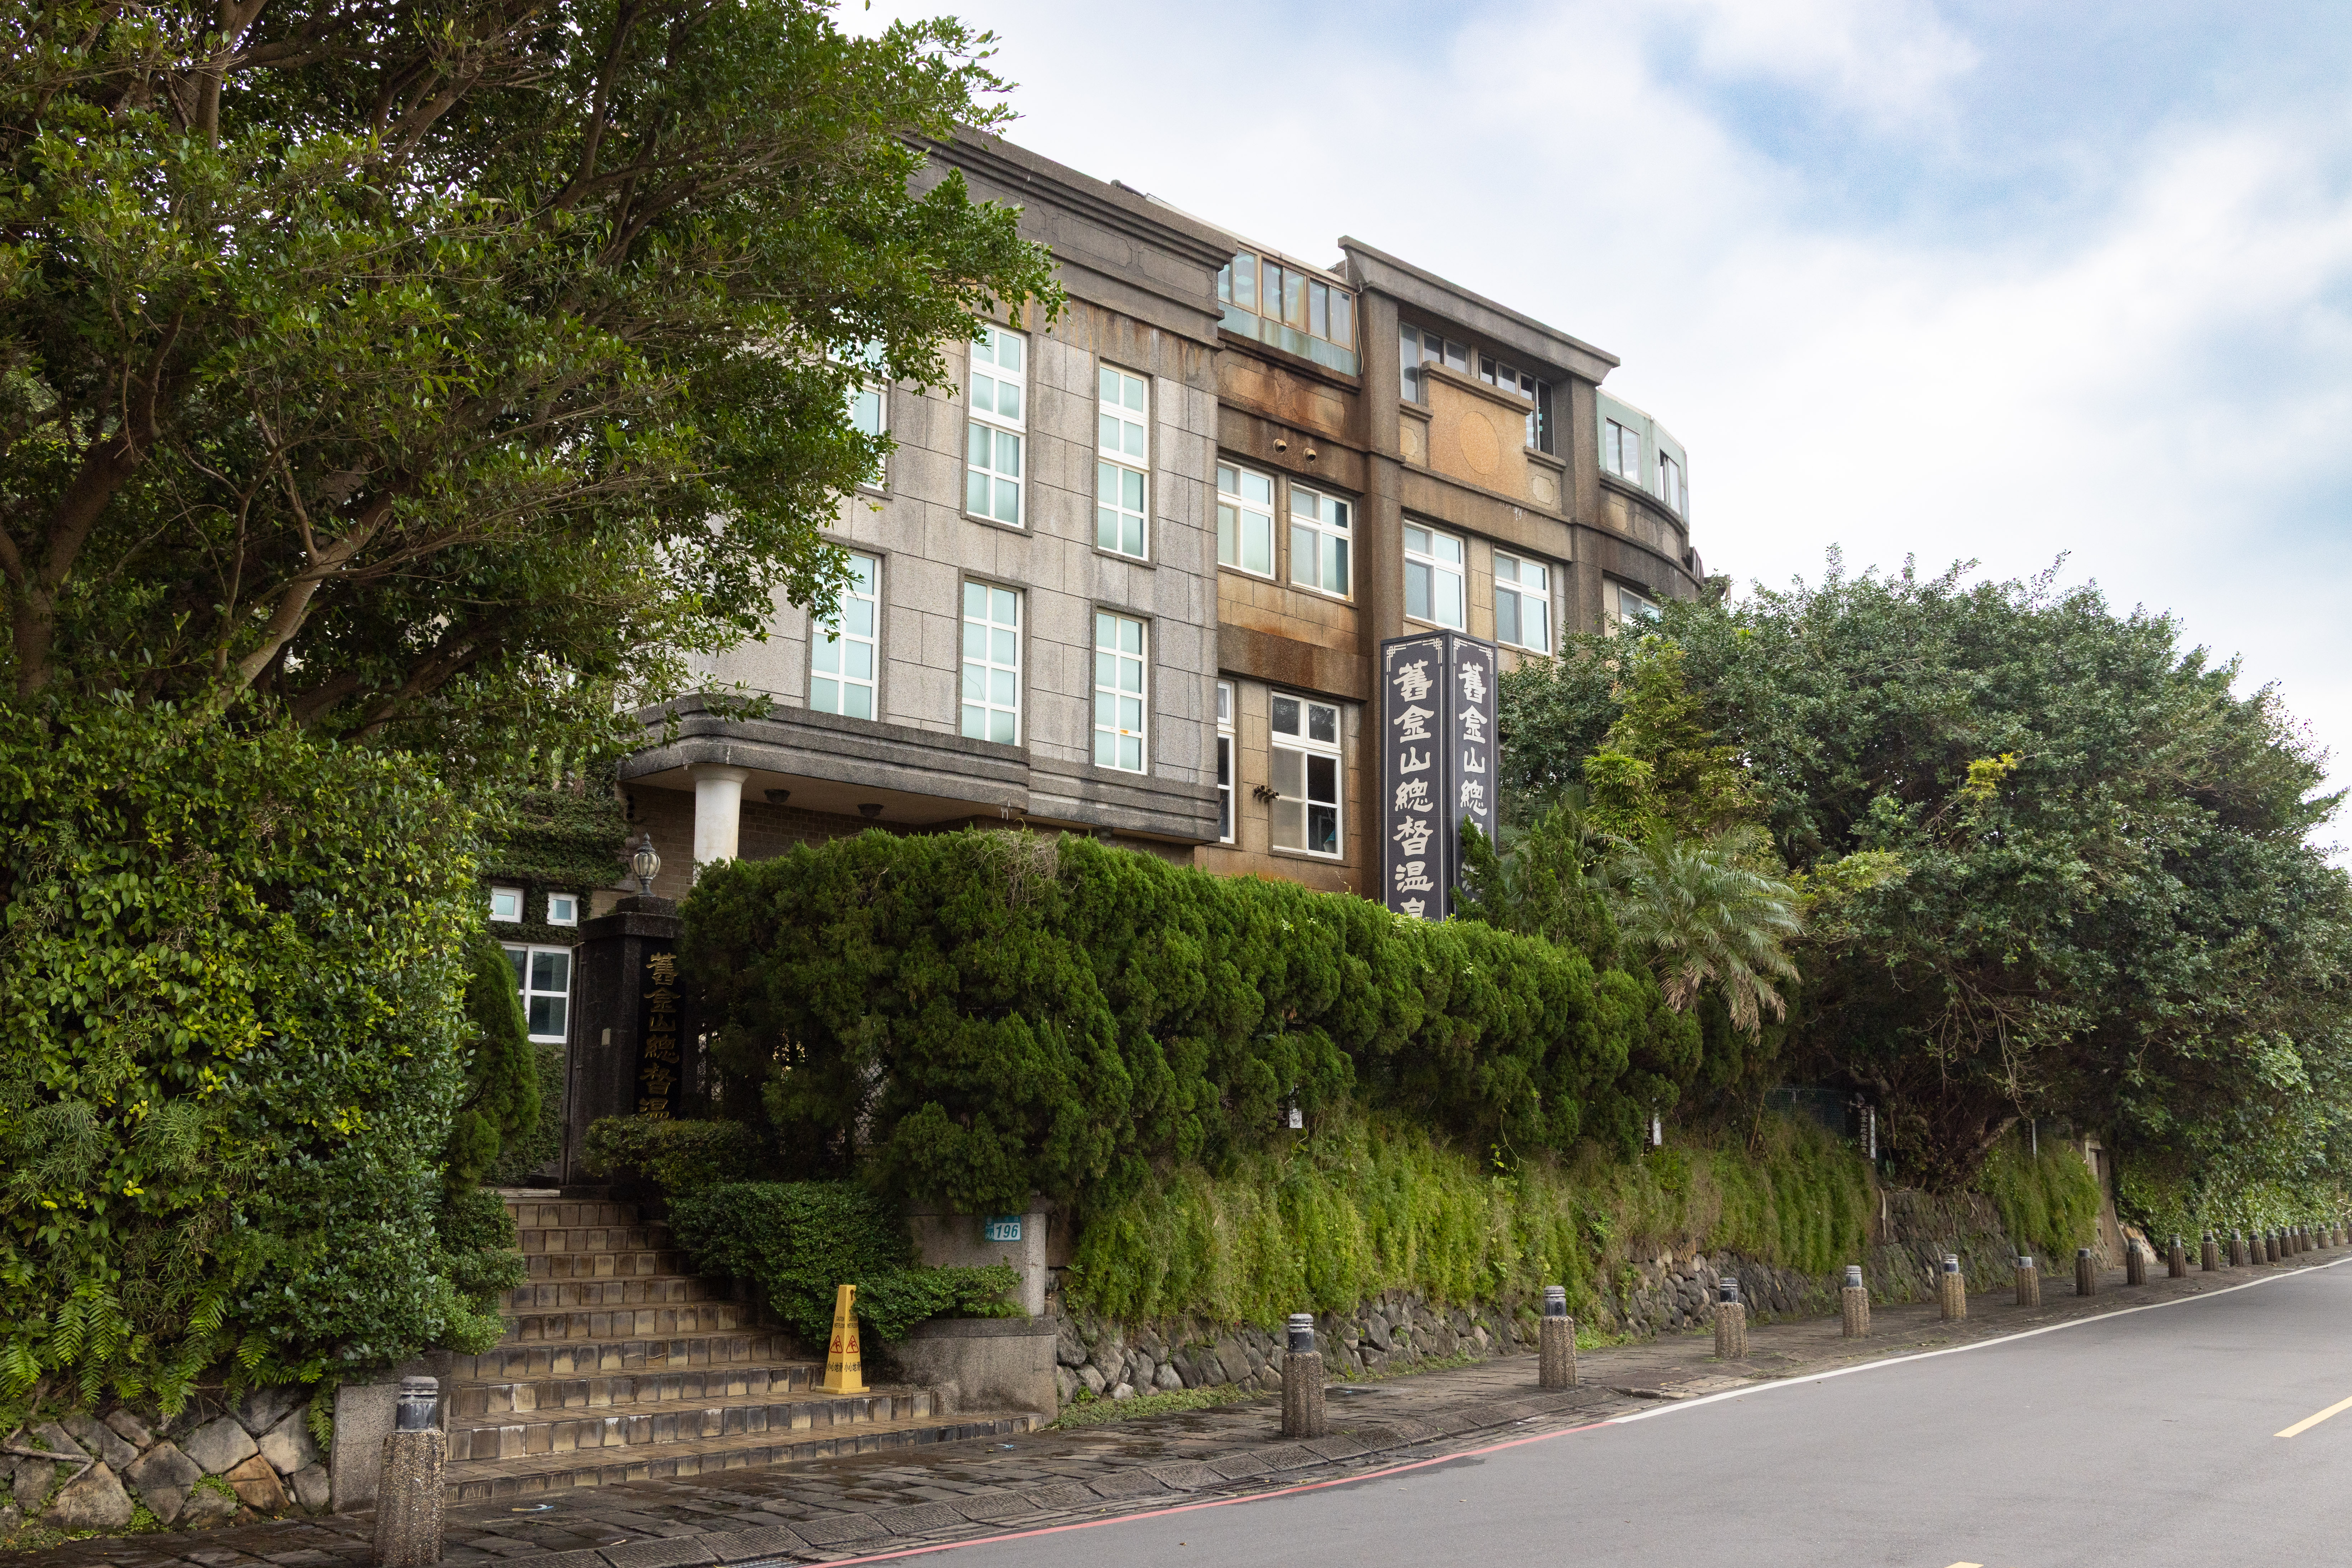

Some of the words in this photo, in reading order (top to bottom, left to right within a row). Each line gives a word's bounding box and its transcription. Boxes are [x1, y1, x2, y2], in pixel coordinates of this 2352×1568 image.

[996, 1225, 1019, 1238] 196
[827, 1361, 843, 1372] 小心地滑
[844, 1361, 861, 1372] 小心地滑
